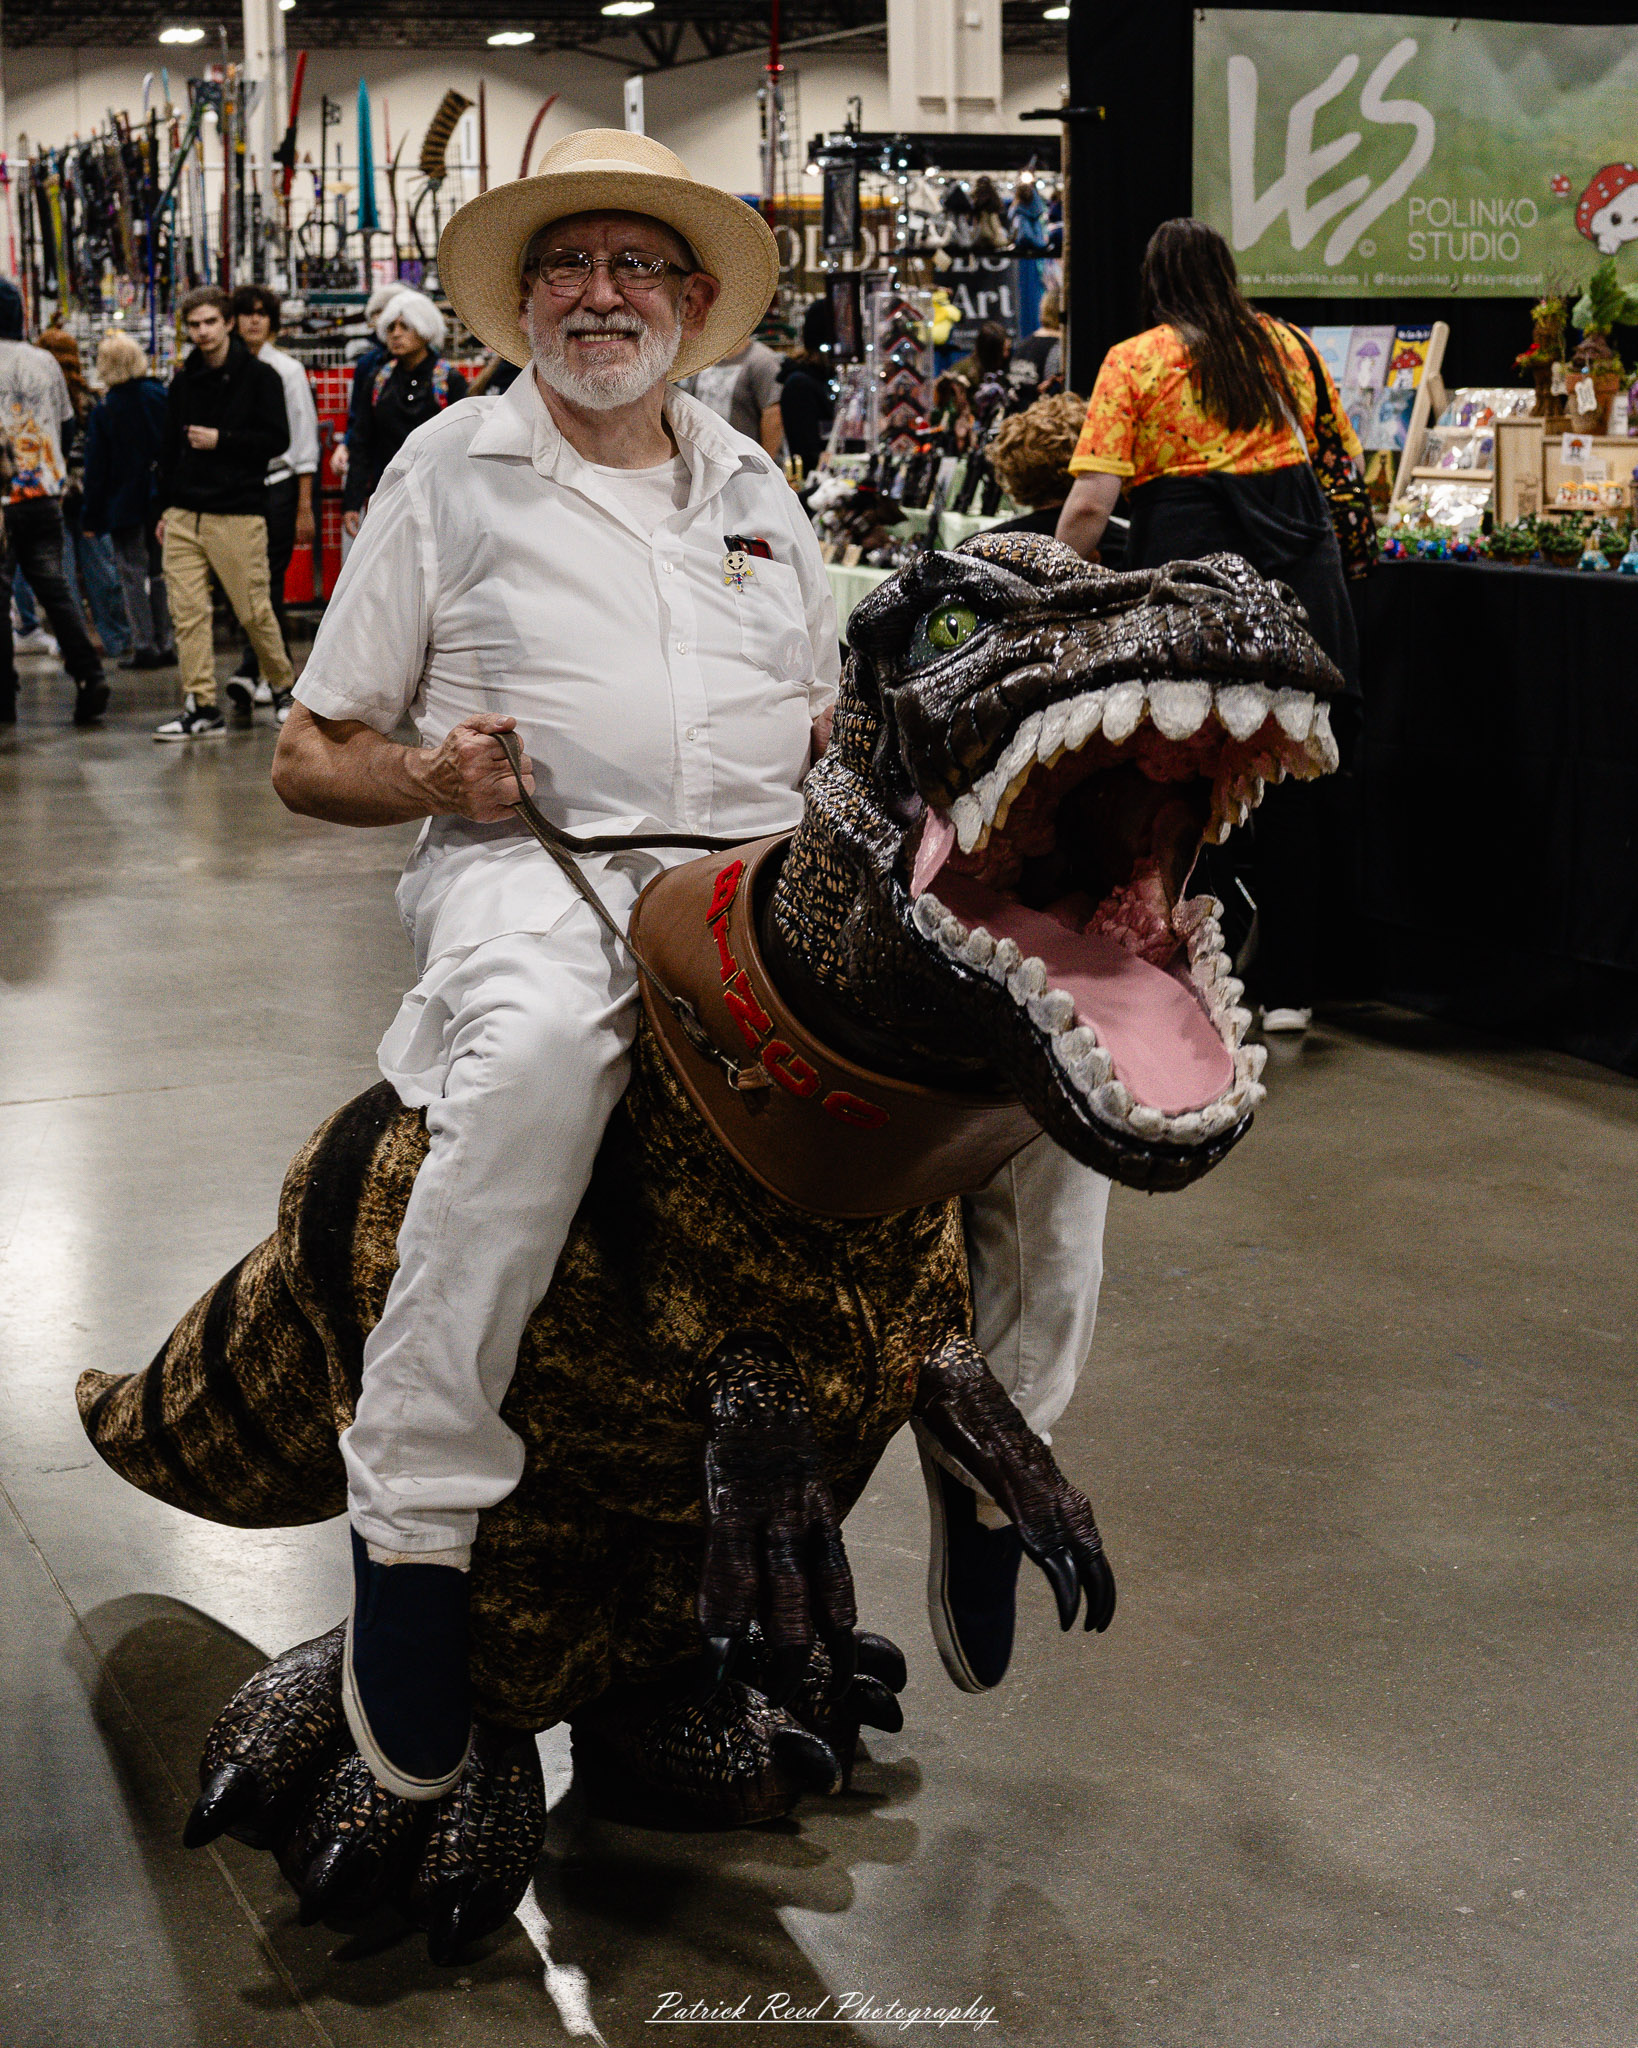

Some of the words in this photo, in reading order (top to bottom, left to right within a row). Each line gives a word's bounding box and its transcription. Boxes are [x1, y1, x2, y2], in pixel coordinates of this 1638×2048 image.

[1227, 38, 1436, 266] LES
[1408, 197, 1539, 228] POLINKO
[1408, 231, 1521, 262] STUDIO
[952, 283, 1015, 319] Art
[705, 859, 891, 1129] BINGO
